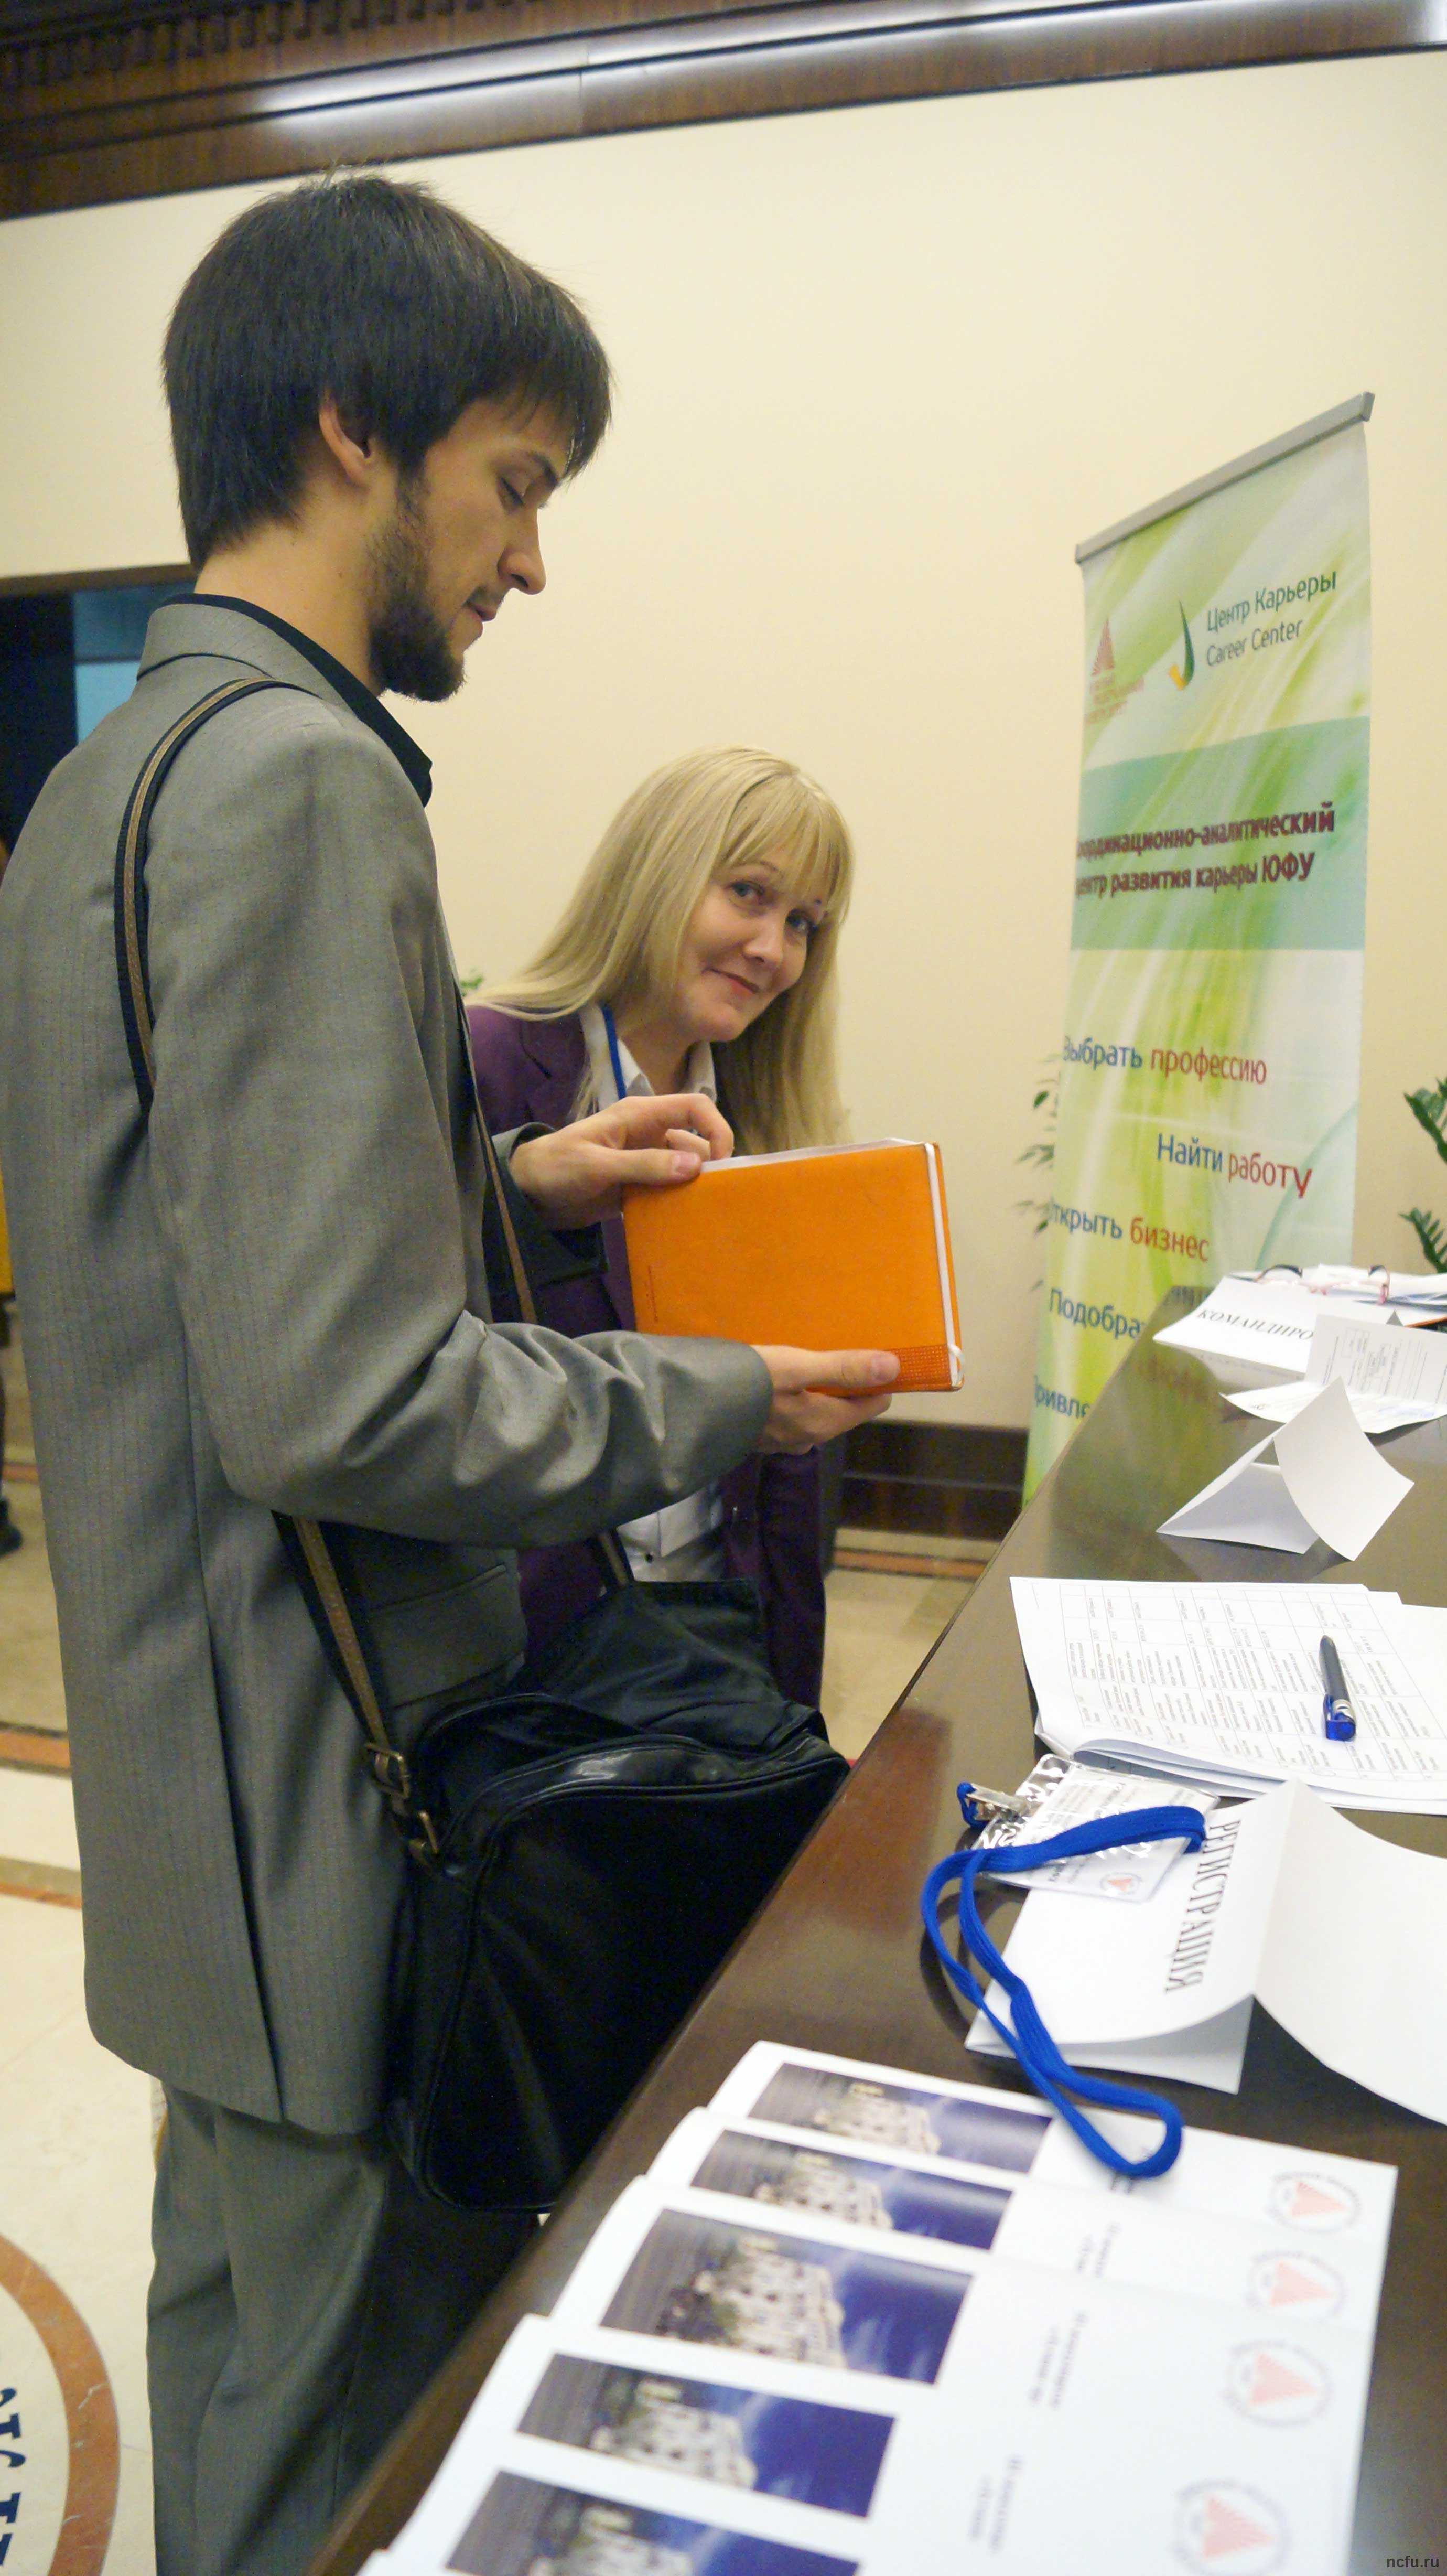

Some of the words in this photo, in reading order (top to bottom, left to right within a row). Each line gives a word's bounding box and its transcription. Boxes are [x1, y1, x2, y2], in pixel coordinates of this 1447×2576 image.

[1207, 600, 1250, 633] Центр
[1255, 571, 1336, 614] Карьеры
[1207, 638, 1246, 667] Career
[1251, 620, 1303, 651] Center
[1111, 868, 1191, 898] развития
[1196, 862, 1258, 893] карьеры
[1262, 851, 1315, 883] ЮФУ
[1151, 1046, 1267, 1085] профессию
[1157, 1133, 1223, 1173] Найти
[1228, 1152, 1312, 1199] работу
[1049, 1201, 1122, 1239] ткрыть
[1130, 1216, 1209, 1262] бизнес
[1049, 1287, 1146, 1340] Подобра
[1198, 1310, 1314, 1340] КОМАНДИРО
[1165, 1820, 1240, 1993] РЕГИСТРАЦИЯ
